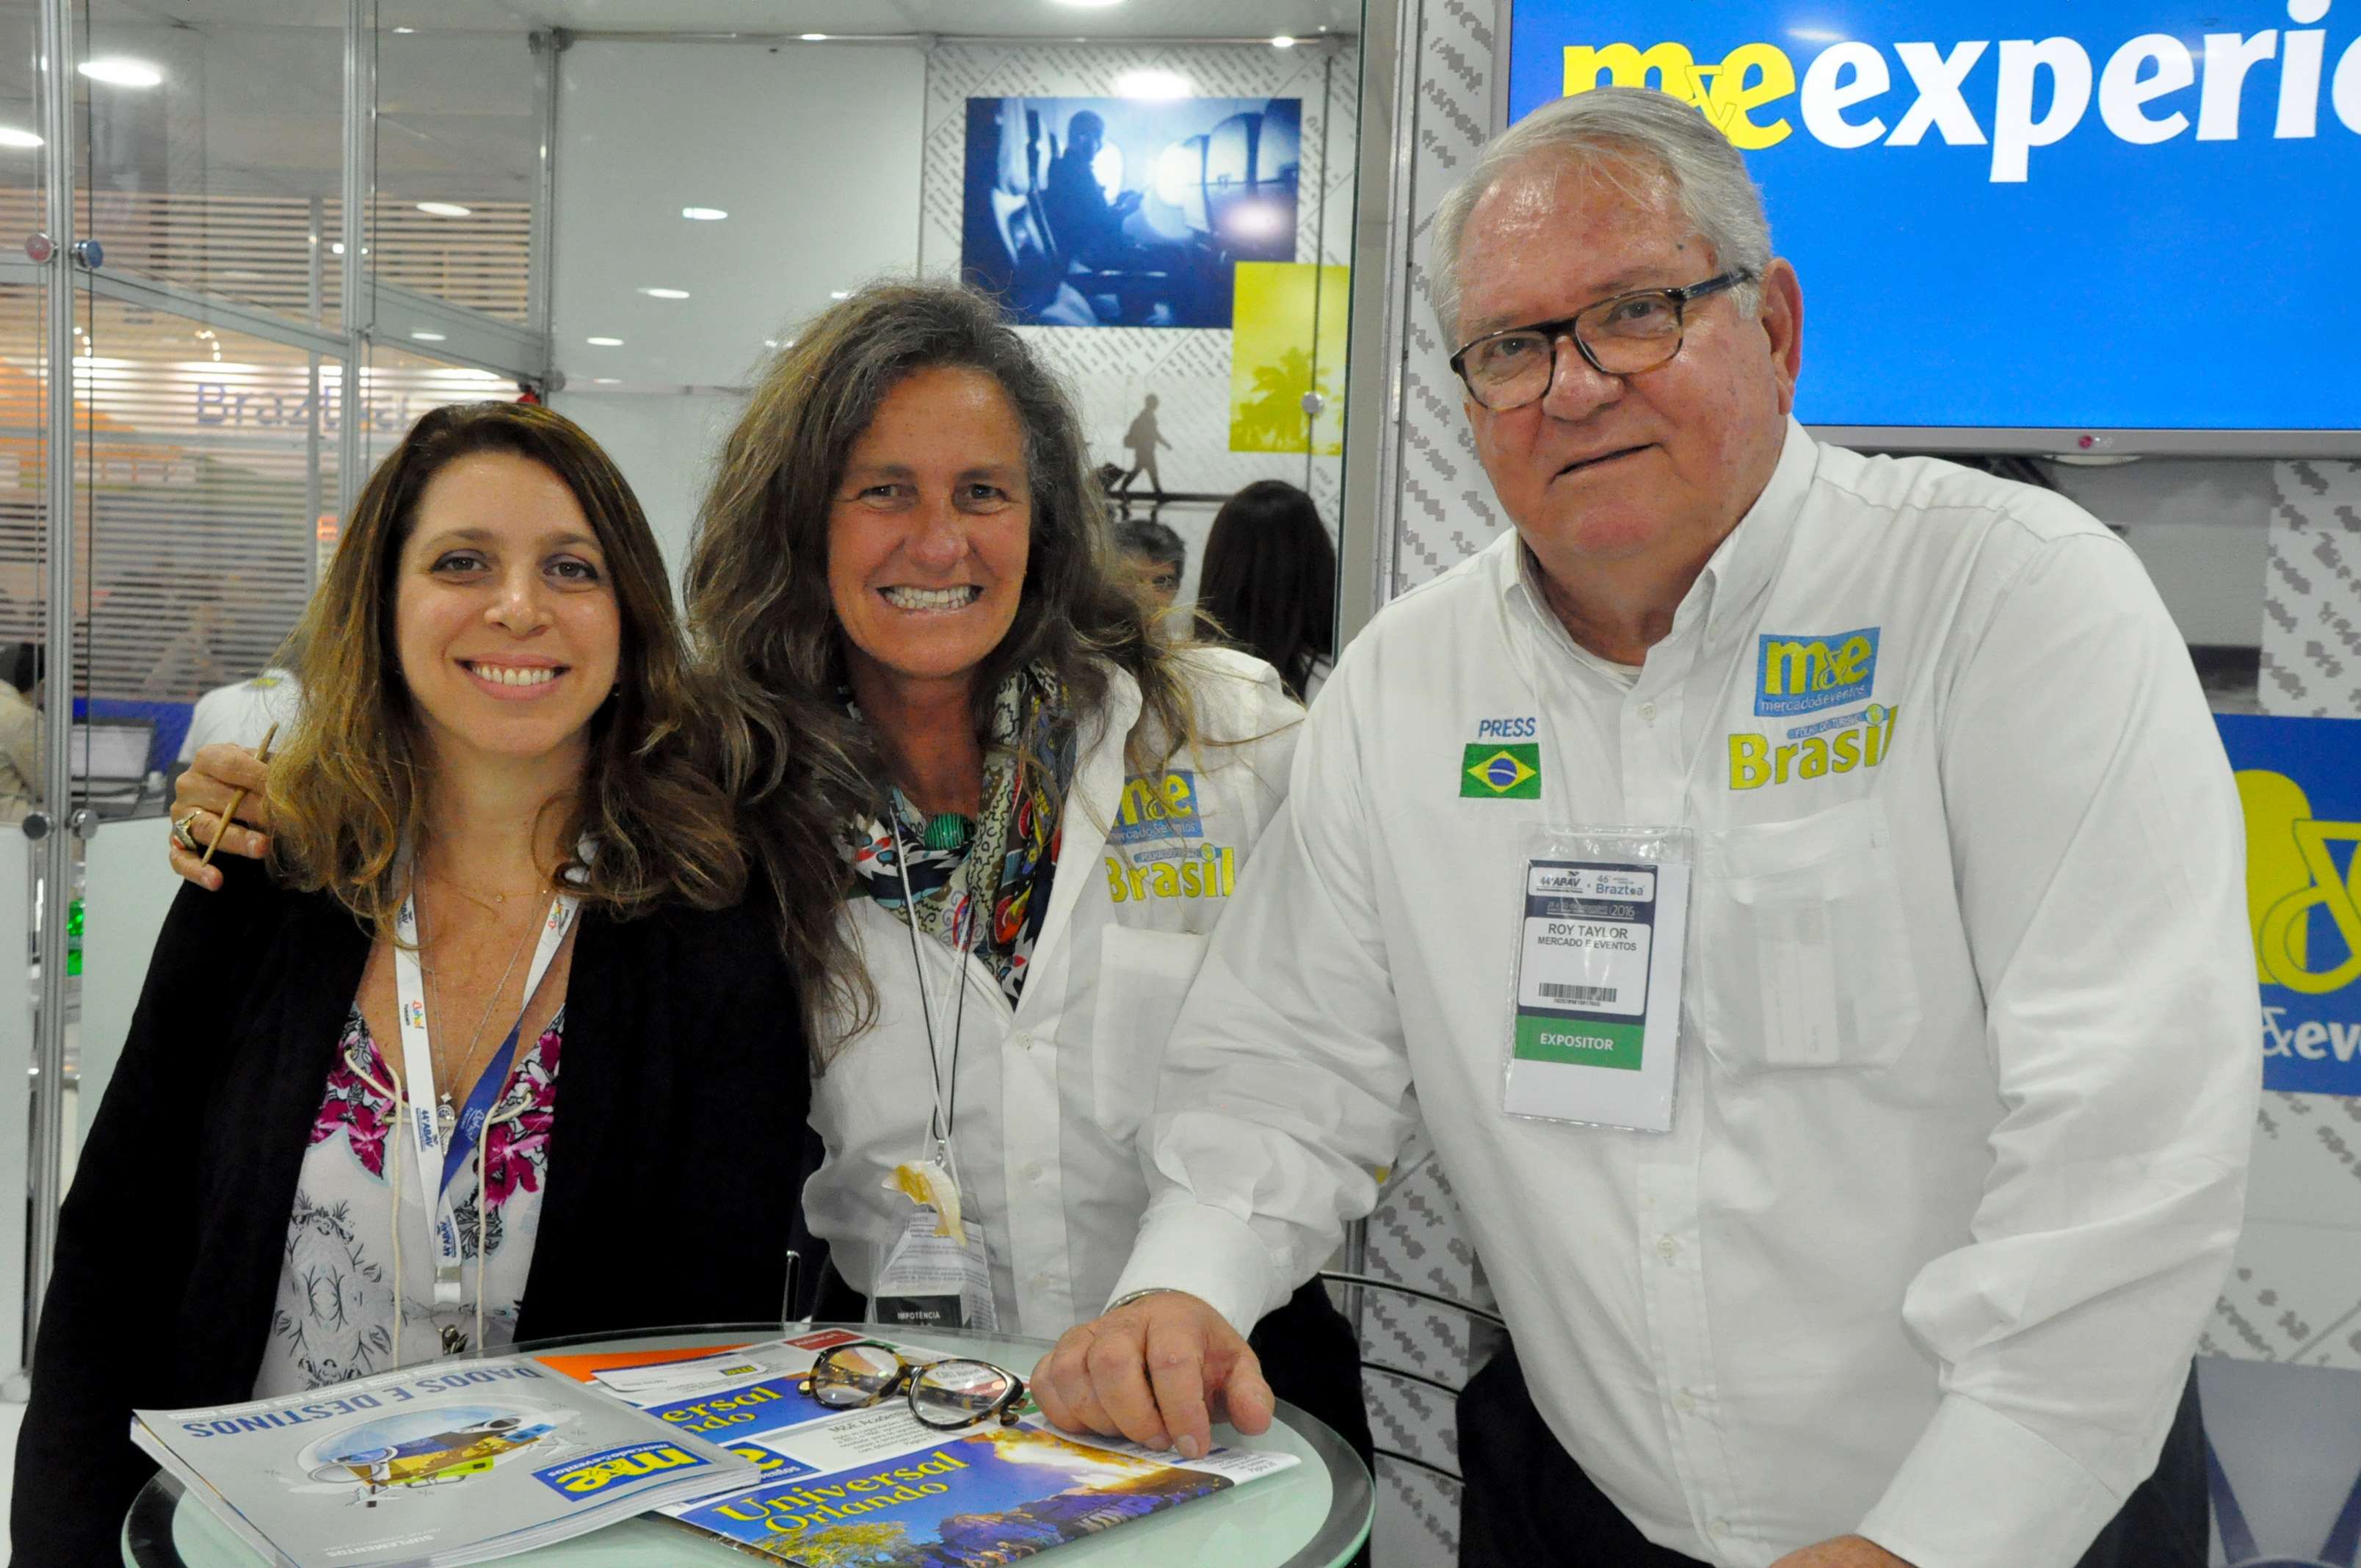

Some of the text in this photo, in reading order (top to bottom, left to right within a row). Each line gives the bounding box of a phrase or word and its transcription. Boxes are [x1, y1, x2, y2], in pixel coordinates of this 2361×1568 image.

[1765, 635, 1873, 694] m&e
[1762, 684, 1866, 711] mercado&eventos
[1479, 716, 1536, 738] PRESS
[1729, 705, 1898, 790] Brasil
[1105, 847, 1236, 903] Brasil
[1596, 883, 1644, 896] Braztoa
[1611, 904, 1635, 917] 2016
[1538, 936, 1584, 948] MERCADO
[1594, 940, 1636, 951] EVENTOS
[1548, 923, 1628, 939] ROY TAYLOR
[1540, 1033, 1614, 1051] EXPOSITOR
[423, 1122, 433, 1148] ABAV
[897, 1311, 940, 1321] IMPOTÊNCIA
[415, 1368, 544, 1393] DADOS
[382, 1387, 415, 1402] E
[662, 1386, 784, 1422] ersal
[183, 1394, 383, 1437] DESTINOS
[548, 1444, 669, 1477] mercado&eventos
[555, 1448, 698, 1492] m&e
[712, 1451, 971, 1521] Universal
[765, 1482, 949, 1533] Orlando
[327, 1534, 435, 1557] SUPLEMENTOS
